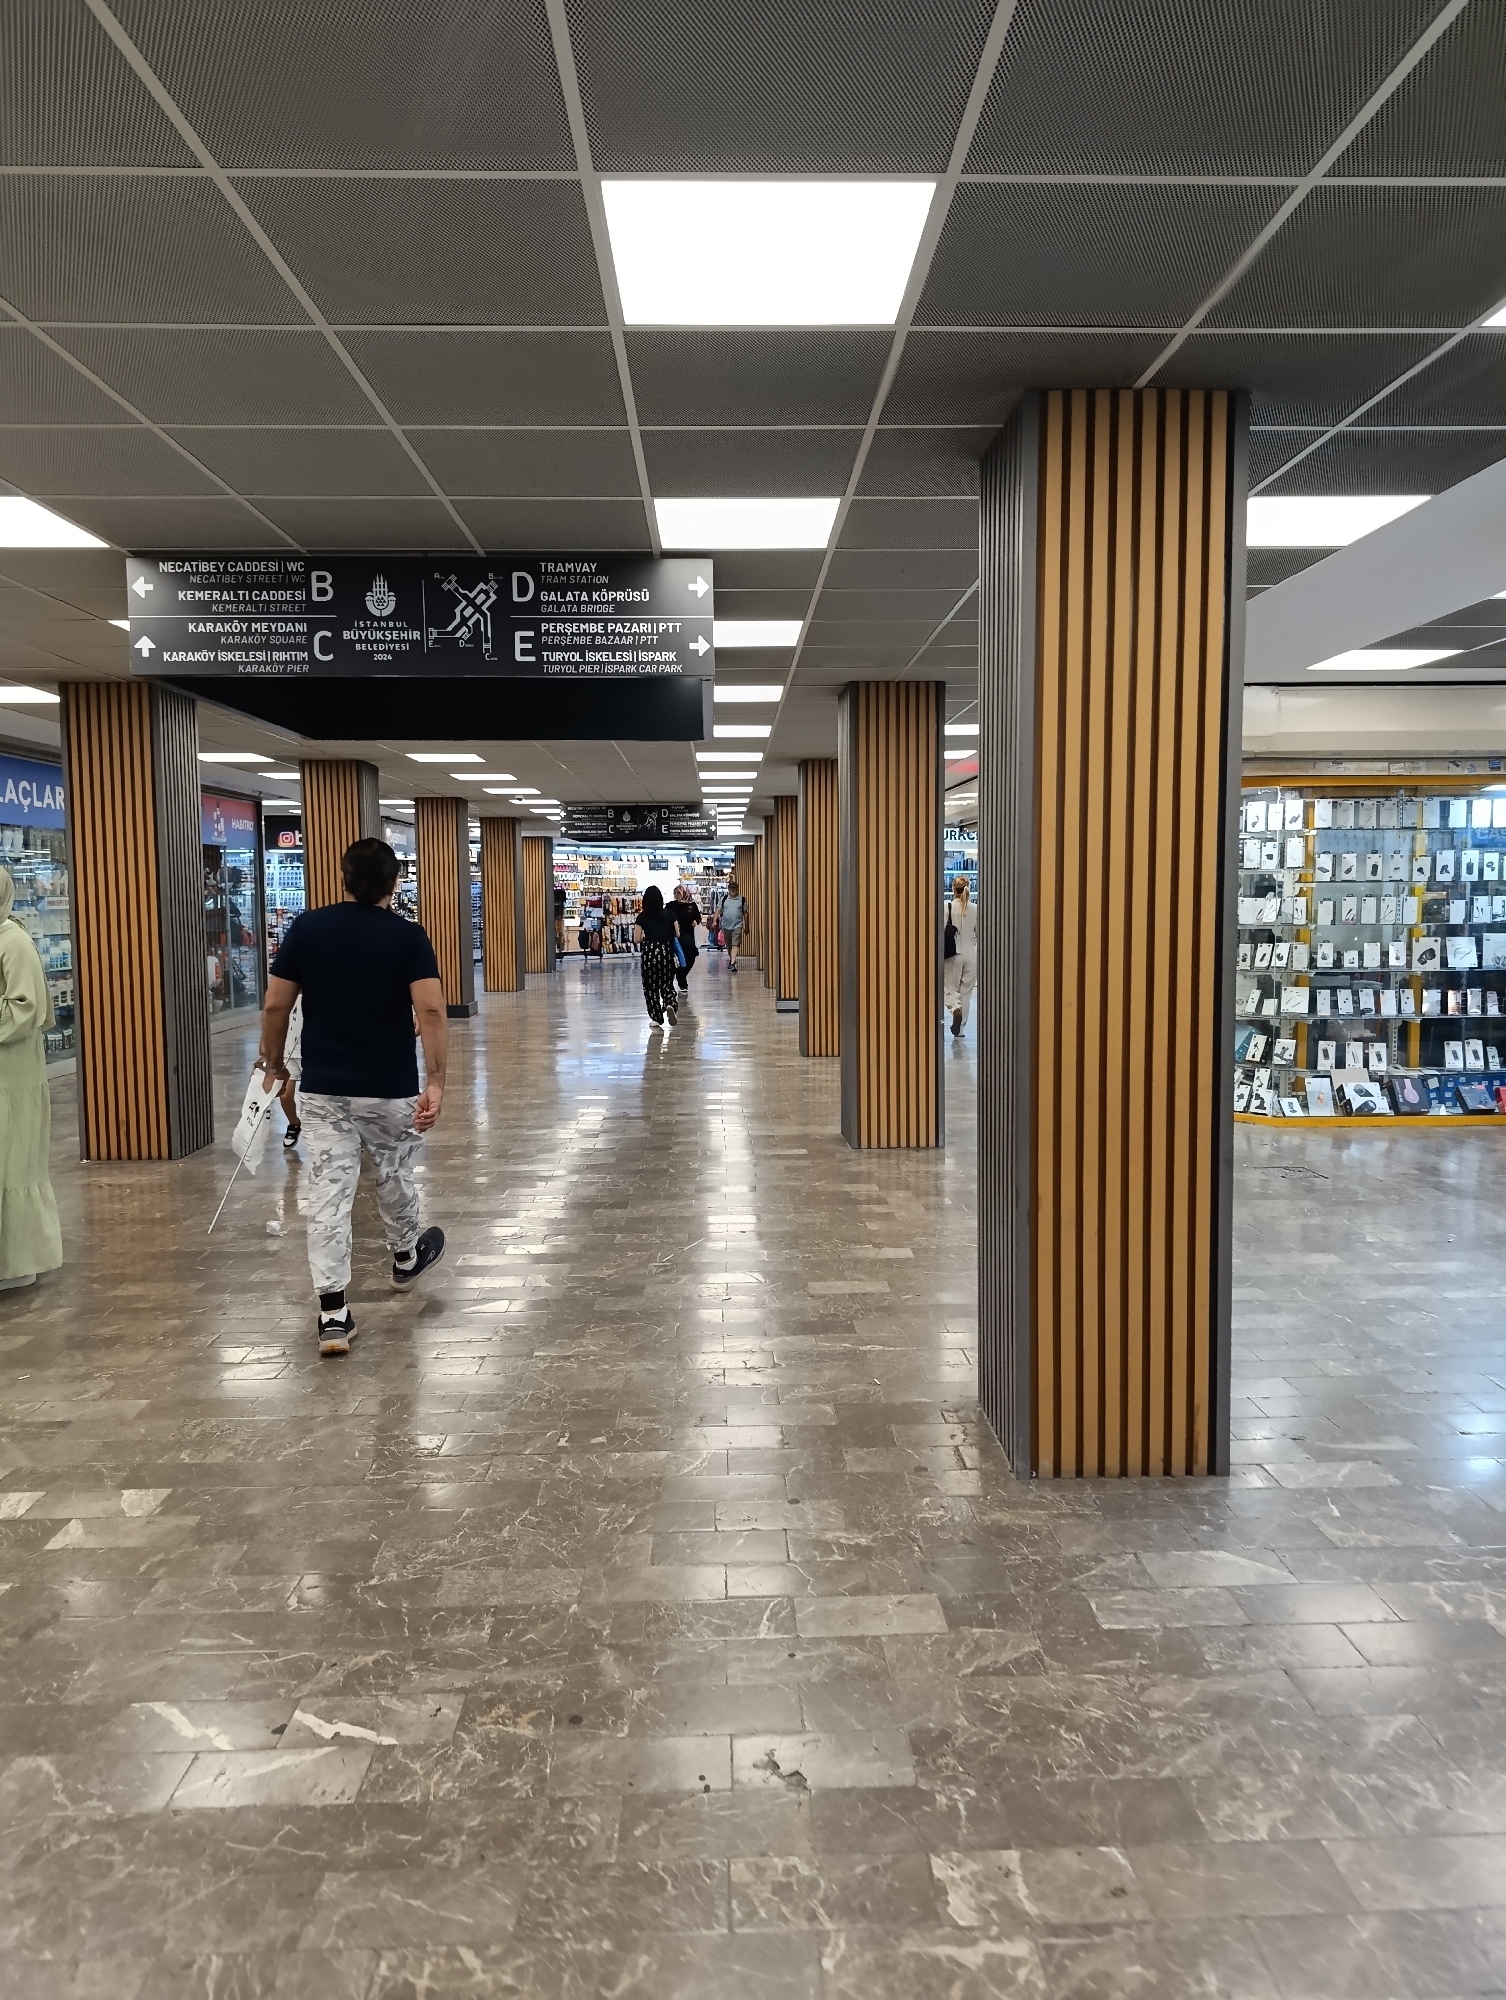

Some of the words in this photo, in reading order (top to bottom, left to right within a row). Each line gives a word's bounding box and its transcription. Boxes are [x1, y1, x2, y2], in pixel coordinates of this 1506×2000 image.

[159, 560, 225, 573] NECATİBEY
[227, 559, 279, 573] CADDESİ
[286, 561, 305, 572] WC
[539, 562, 597, 573] TRAMVAY
[246, 574, 284, 584] STREET
[290, 574, 306, 583] WC
[540, 575, 567, 584] TRAM
[569, 575, 609, 584] STATION
[311, 570, 334, 602] B
[511, 571, 535, 603] D
[178, 590, 250, 601] KEMERALTI
[251, 588, 306, 601] CADDESİ
[540, 591, 589, 602] GALATA
[592, 588, 650, 602] KÖPRÜSÜ
[211, 603, 267, 613] KEMERALTI
[269, 603, 307, 612] STREET
[540, 604, 578, 613] GALATA
[580, 604, 616, 613] BRIDGE
[188, 619, 249, 633] KARAKÖY
[251, 622, 308, 633] MEYDANI
[354, 619, 409, 628] İSTANBUL
[541, 622, 606, 636] PERŞEMBE
[607, 622, 652, 633] PAZARI
[658, 622, 682, 634] PTT
[220, 633, 267, 645] KARAKÖY
[269, 635, 309, 645] SQUARE
[342, 628, 421, 641] BÜYÜKŞEHİR
[541, 635, 593, 647] PERŞEMBE
[594, 635, 634, 645] BAZAAR
[640, 635, 659, 645] PTT
[313, 630, 335, 662] C
[355, 642, 410, 651] BELEDİYESİ
[514, 630, 536, 662] E
[163, 649, 216, 662] KARAKÖY
[217, 649, 266, 662] İSKELESİ
[272, 651, 308, 662] RIHTIM
[373, 653, 393, 661] 2024
[541, 651, 584, 662] TURYOL
[585, 649, 633, 662] İSKELESİ
[638, 649, 677, 662] İSPARK
[238, 662, 285, 673] KARAKÖY
[286, 664, 310, 673] PIER
[542, 664, 578, 673] TURYOL
[578, 664, 600, 673] PIER
[604, 662, 638, 673] İSPARK
[639, 664, 658, 673] CAR
[658, 664, 683, 673] PARK
[0, 778, 65, 814] AÇLAR
